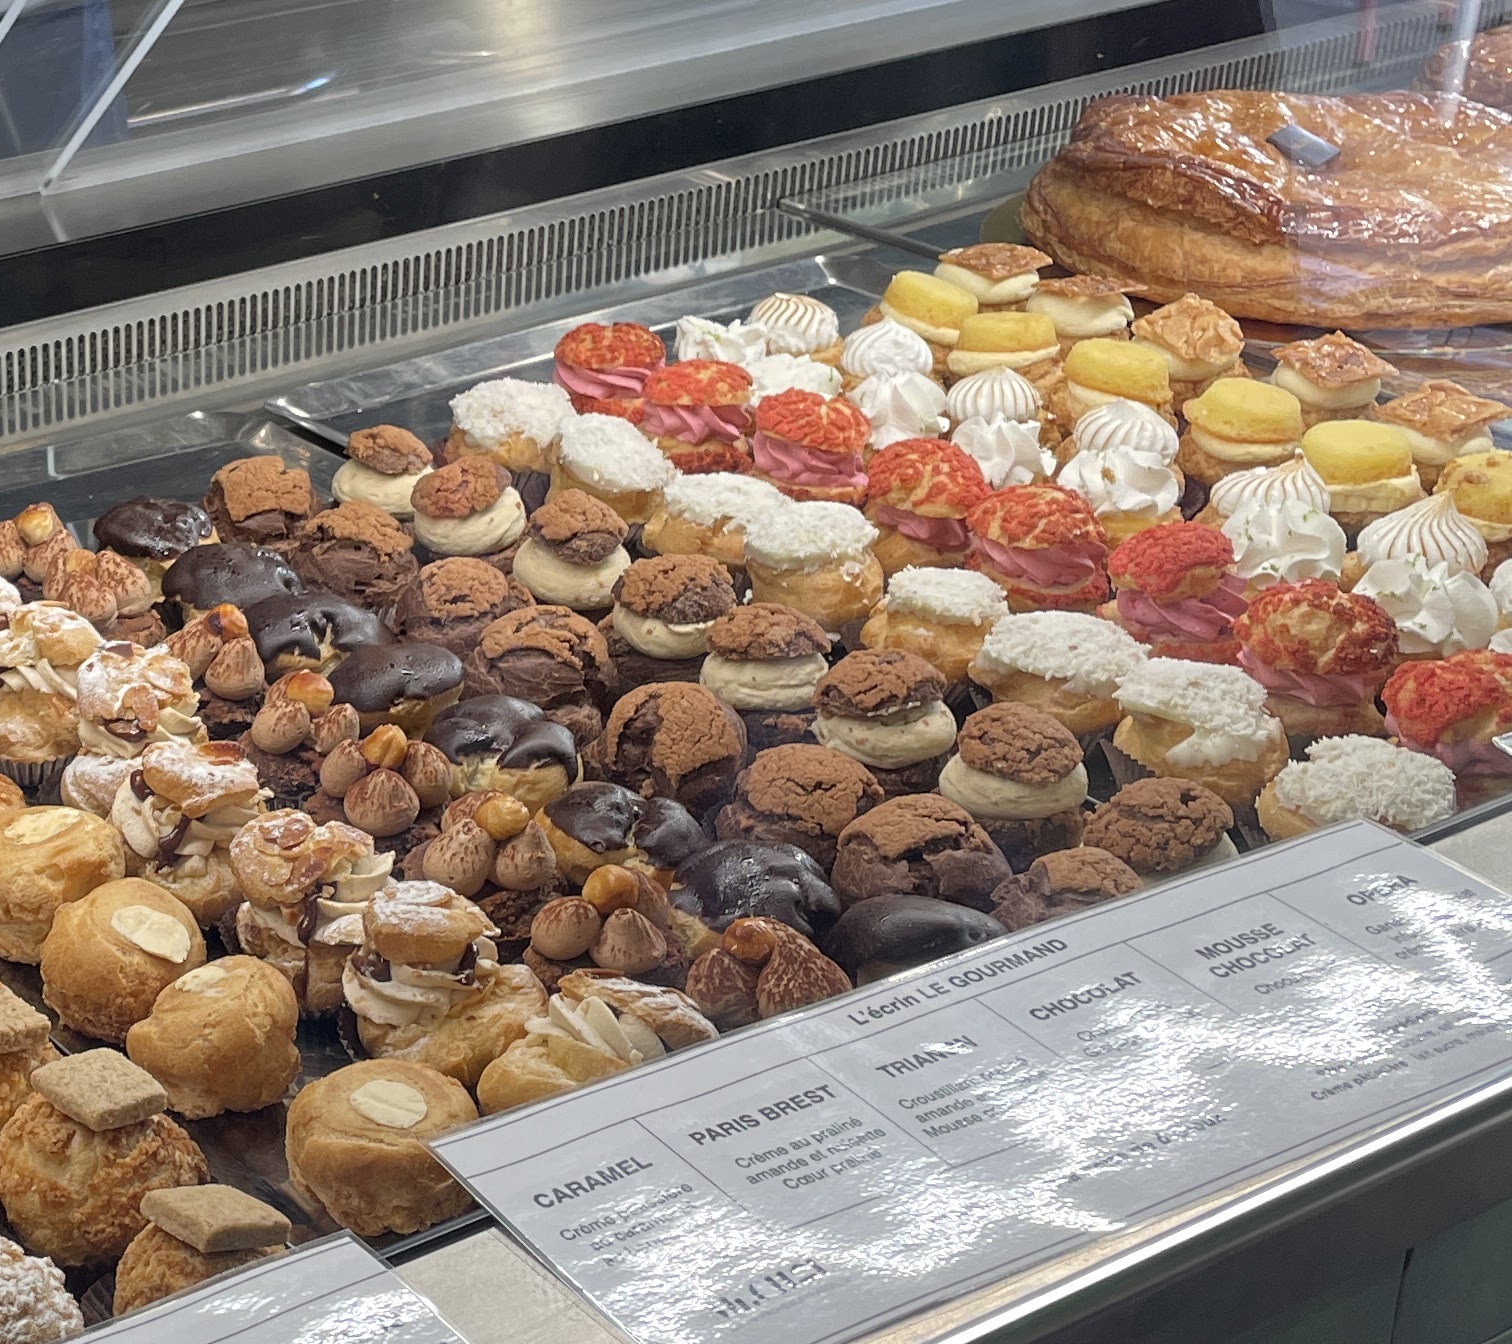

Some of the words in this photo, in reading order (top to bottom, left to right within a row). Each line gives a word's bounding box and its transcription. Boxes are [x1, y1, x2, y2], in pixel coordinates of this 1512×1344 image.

[1195, 923, 1285, 960] MOUSSE
[847, 990, 920, 1025] L'écrin
[917, 982, 951, 999] LE
[948, 938, 1068, 988] GOURMAND
[1029, 972, 1142, 1021] CHOCOLAT
[875, 1035, 978, 1078] TRIANN
[688, 1114, 760, 1146] PARIS
[758, 1084, 836, 1122] BREST
[915, 1098, 975, 1123] amande
[922, 1114, 983, 1138] Mousse
[735, 1147, 789, 1169] Crème
[792, 1138, 812, 1151] au
[811, 1116, 863, 1144] praliné
[533, 1157, 654, 1208] CARAMEL
[746, 1158, 809, 1185] amande
[809, 1149, 828, 1163] et
[782, 1167, 829, 1189] Cœur
[560, 1215, 616, 1241] Crème
